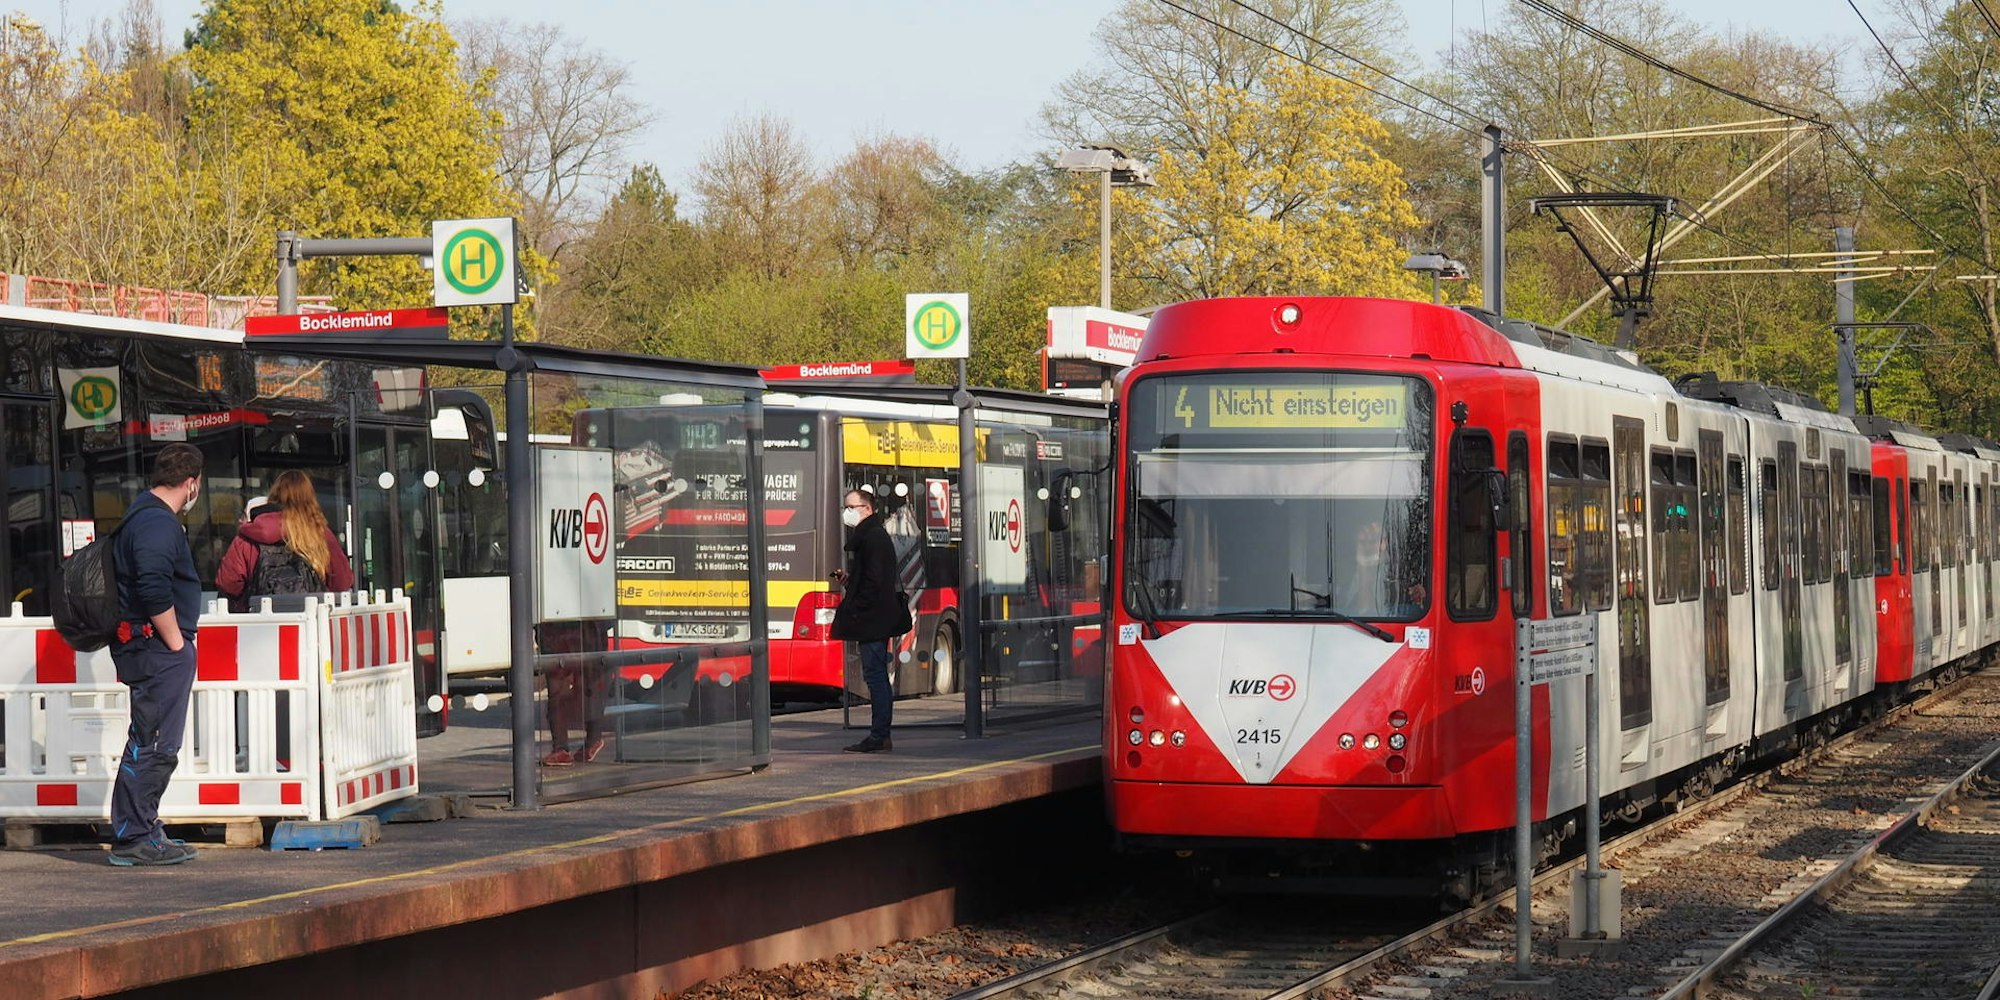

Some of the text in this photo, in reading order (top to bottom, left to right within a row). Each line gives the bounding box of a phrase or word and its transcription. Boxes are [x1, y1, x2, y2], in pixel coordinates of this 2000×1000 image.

[300, 312, 393, 331] Bocklemünd
[800, 364, 872, 377] Bocklemünd
[1174, 385, 1398, 428] 4 Nicht einsteigen
[549, 508, 583, 548] KVB
[989, 511, 1008, 541] KVB
[1228, 679, 1267, 695] KVB
[1455, 674, 1472, 691] KVB
[1237, 728, 1281, 744] 2415
